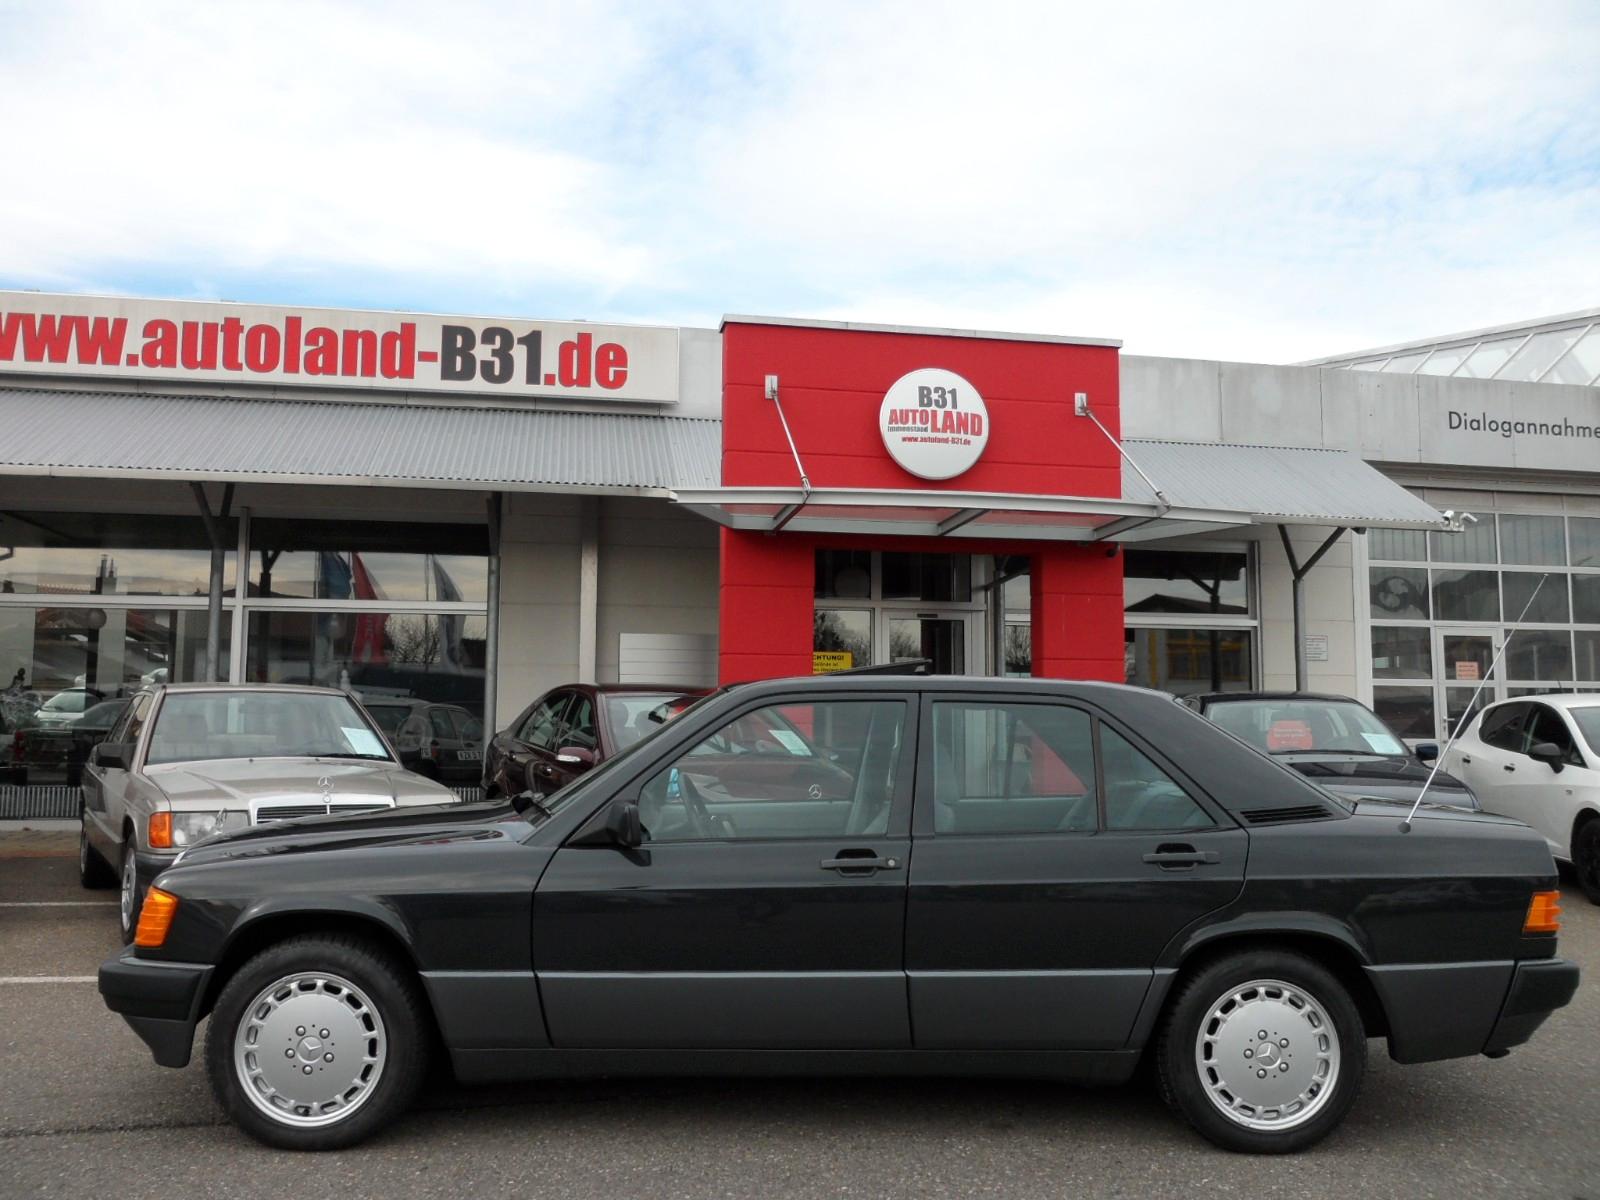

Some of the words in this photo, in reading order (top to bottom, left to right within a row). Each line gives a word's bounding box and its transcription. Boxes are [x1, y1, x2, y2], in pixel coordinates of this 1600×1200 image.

[918, 386, 958, 409] B31
[1449, 411, 1600, 438] Dialogannahme
[901, 435, 972, 446] www.autoland-B31.de
